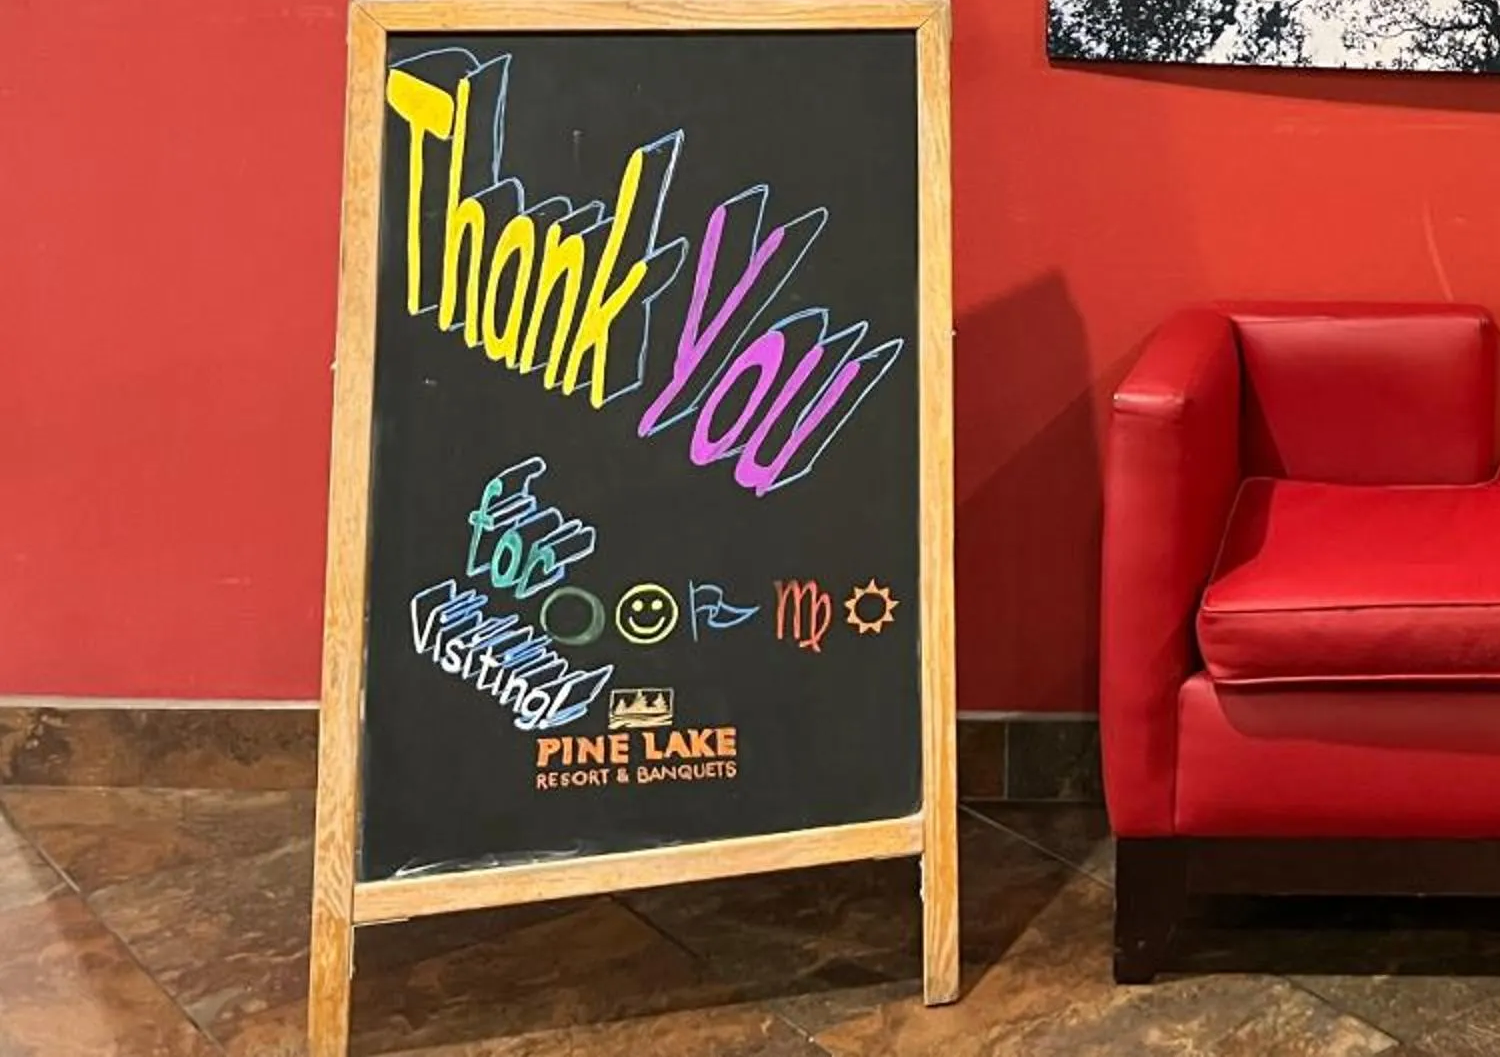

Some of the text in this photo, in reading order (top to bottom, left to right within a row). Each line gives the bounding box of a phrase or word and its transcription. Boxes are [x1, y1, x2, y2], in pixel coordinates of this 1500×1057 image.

[387, 65, 650, 409] Thank
[467, 468, 572, 599] for
[410, 583, 584, 730] Visiting!
[536, 727, 737, 767] PINE LAKE
[536, 761, 737, 790] RESORT & BANQUETS
